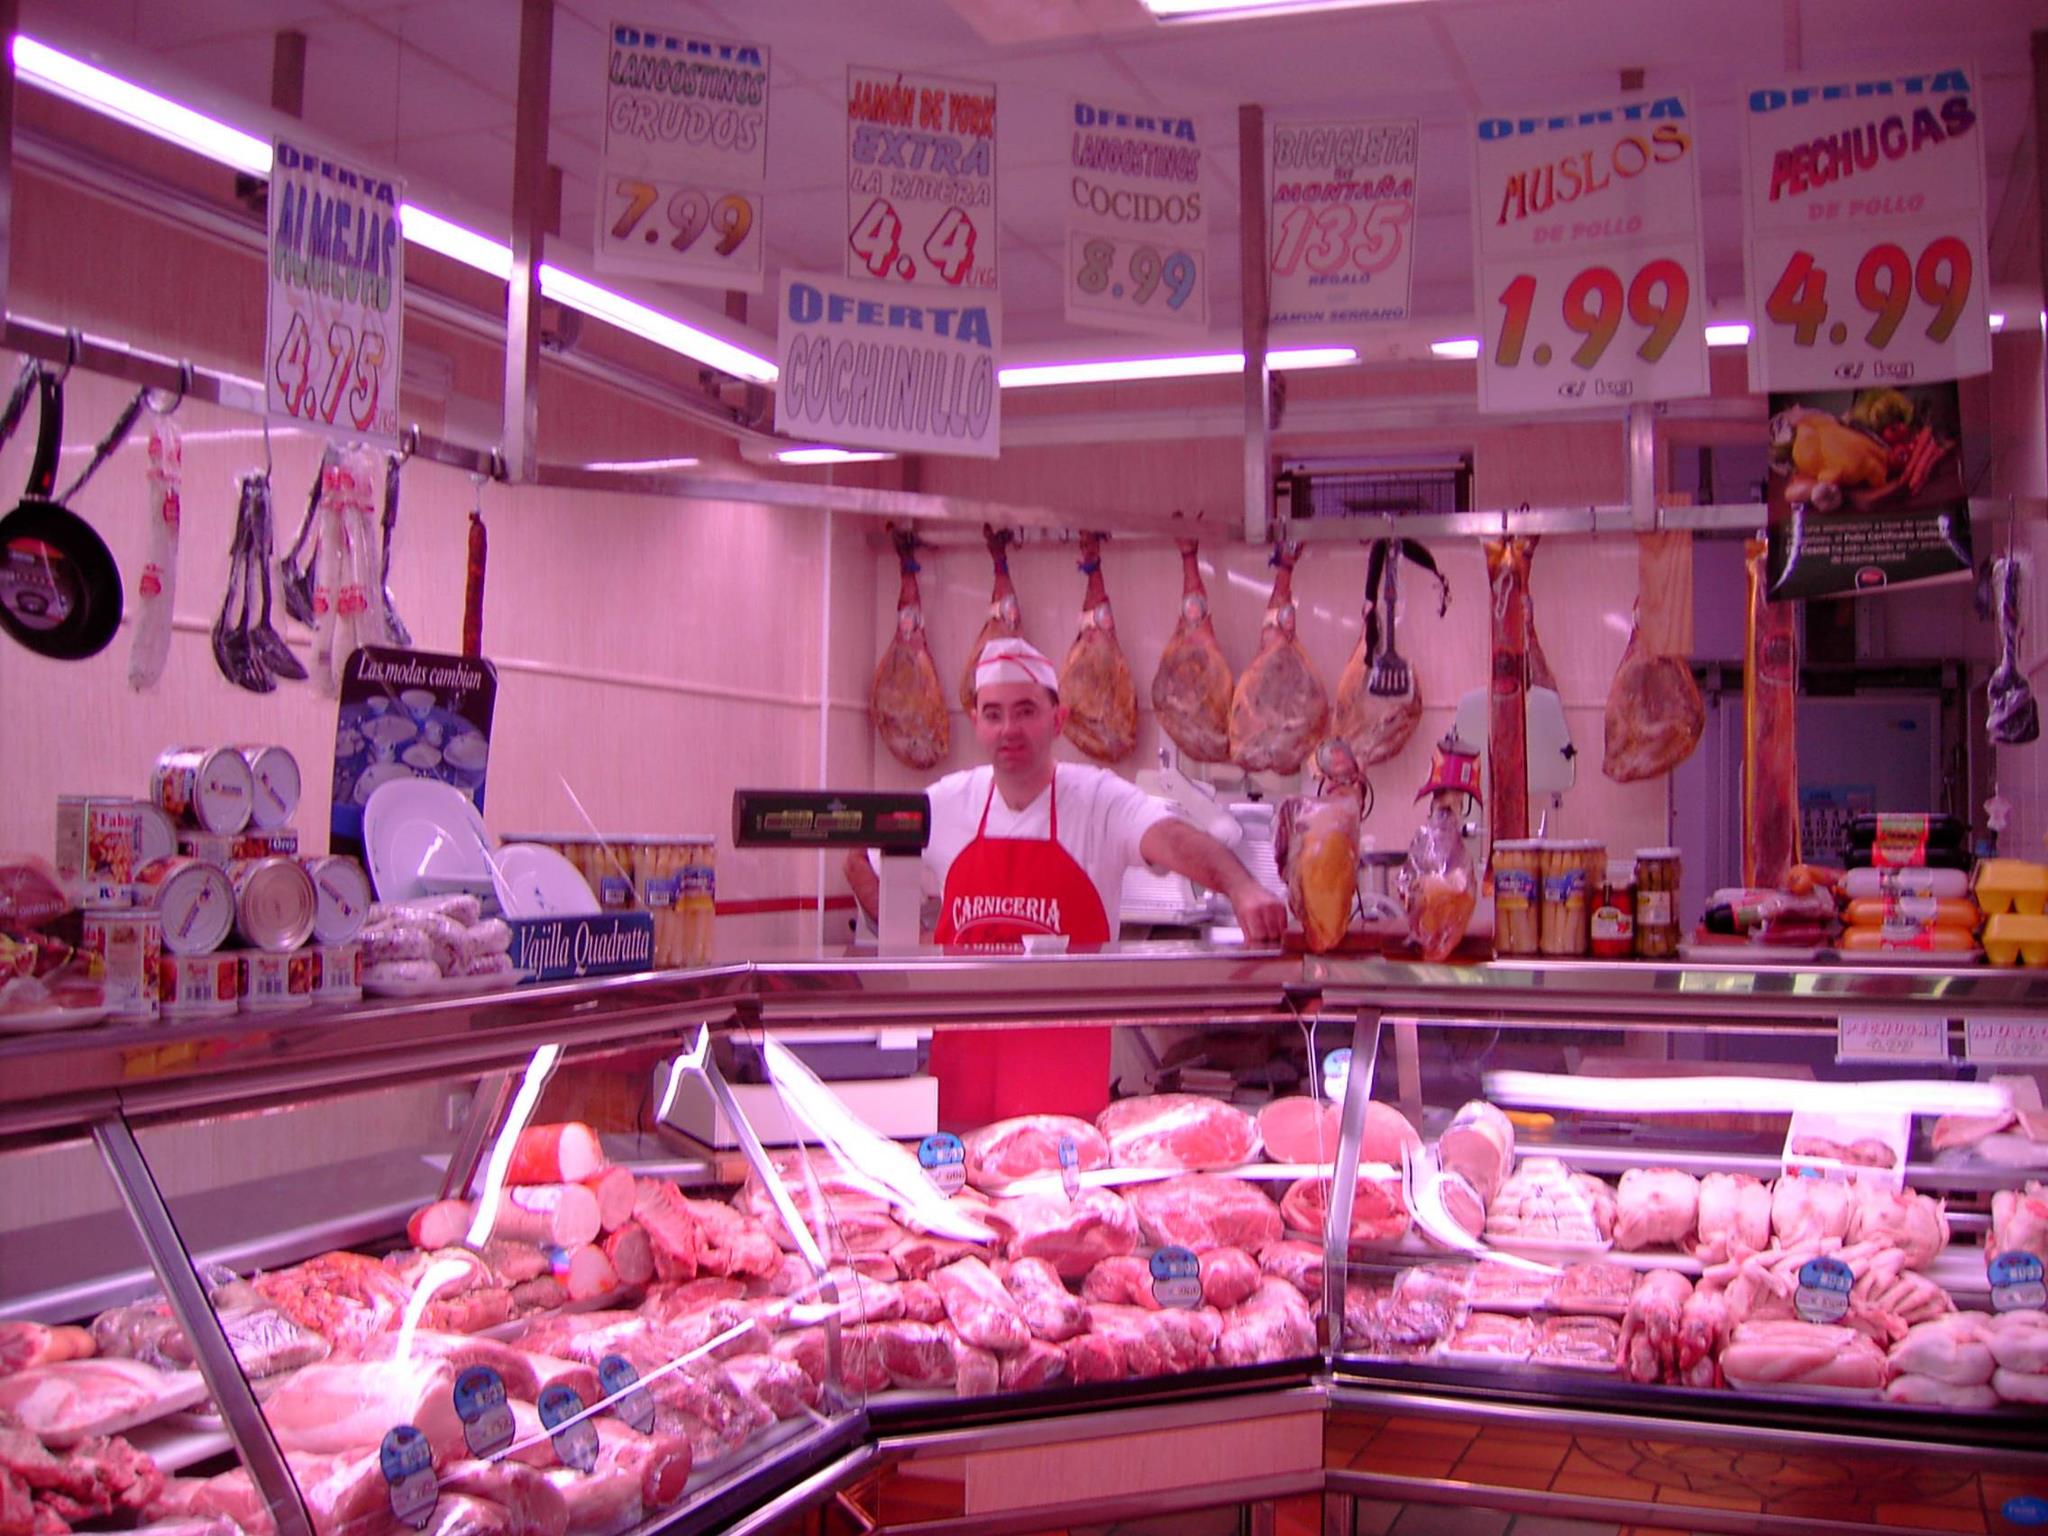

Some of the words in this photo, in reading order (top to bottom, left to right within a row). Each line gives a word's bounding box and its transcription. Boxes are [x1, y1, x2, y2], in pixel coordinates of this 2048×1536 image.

[615, 26, 762, 66] OFERTA
[920, 87, 945, 132] DE
[1478, 97, 1686, 141] OFERTA
[1750, 69, 1971, 113] OFERTA
[609, 92, 764, 152] CRUDOS
[1074, 101, 1196, 143] OFERTA
[1273, 126, 1417, 170] BICICLETA
[1768, 96, 1976, 202] PECHUGAS
[277, 142, 396, 208] OFERTA
[852, 124, 990, 177] EXTRA
[1496, 124, 1692, 226] MUSLOS
[850, 167, 883, 195] LA
[1072, 175, 1201, 224] COCIDOS
[1273, 173, 1414, 202] MONTAÑA
[1808, 202, 1841, 221] DE
[1850, 193, 1926, 217] POLLO
[611, 179, 754, 257] 7.99
[849, 198, 978, 286] 4.4
[1271, 199, 1414, 278] 135
[1532, 224, 1563, 244] DE
[1571, 214, 1644, 242] POLLO
[1077, 239, 1196, 312] 8.99
[1764, 235, 1973, 350] 4.99
[788, 282, 993, 349] OFERTA
[1495, 257, 1690, 371] 1.99
[275, 310, 387, 433] 4.75
[785, 331, 994, 441] COCHINILLO
[357, 657, 383, 681] Las
[385, 658, 427, 685] modas
[430, 662, 482, 690] cambian
[953, 896, 1060, 934] CARNICERIA
[520, 922, 570, 981] Vajilla
[574, 919, 650, 976] Quadratta
